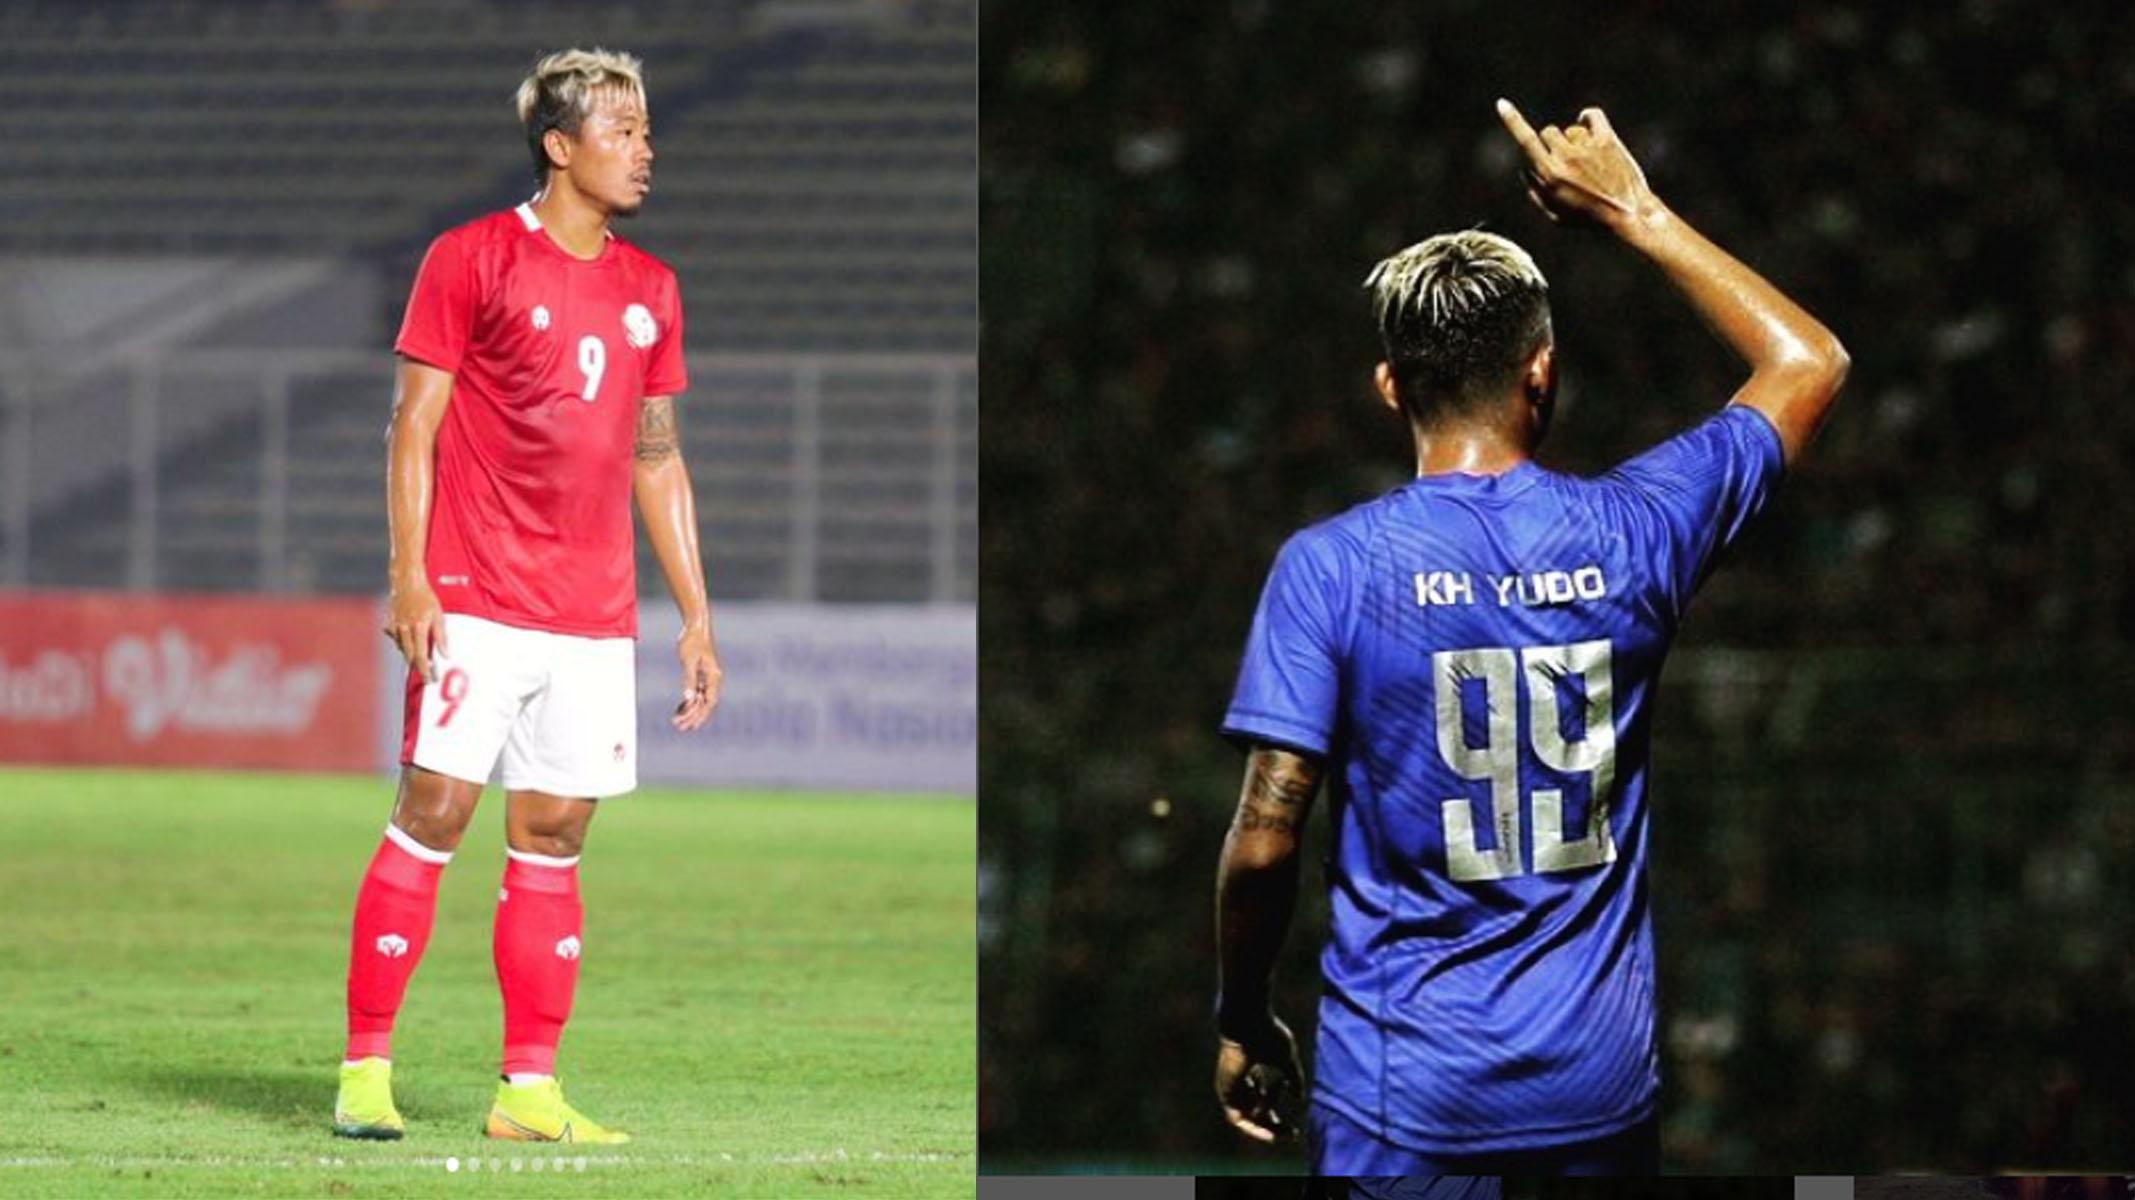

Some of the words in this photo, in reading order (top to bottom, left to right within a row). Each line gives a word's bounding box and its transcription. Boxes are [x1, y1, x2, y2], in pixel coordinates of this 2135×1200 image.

[577, 335, 606, 402] 9
[1414, 571, 1473, 606] KH
[1486, 566, 1606, 607] YUDO
[434, 667, 470, 729] 9
[1433, 638, 1618, 882] 99
